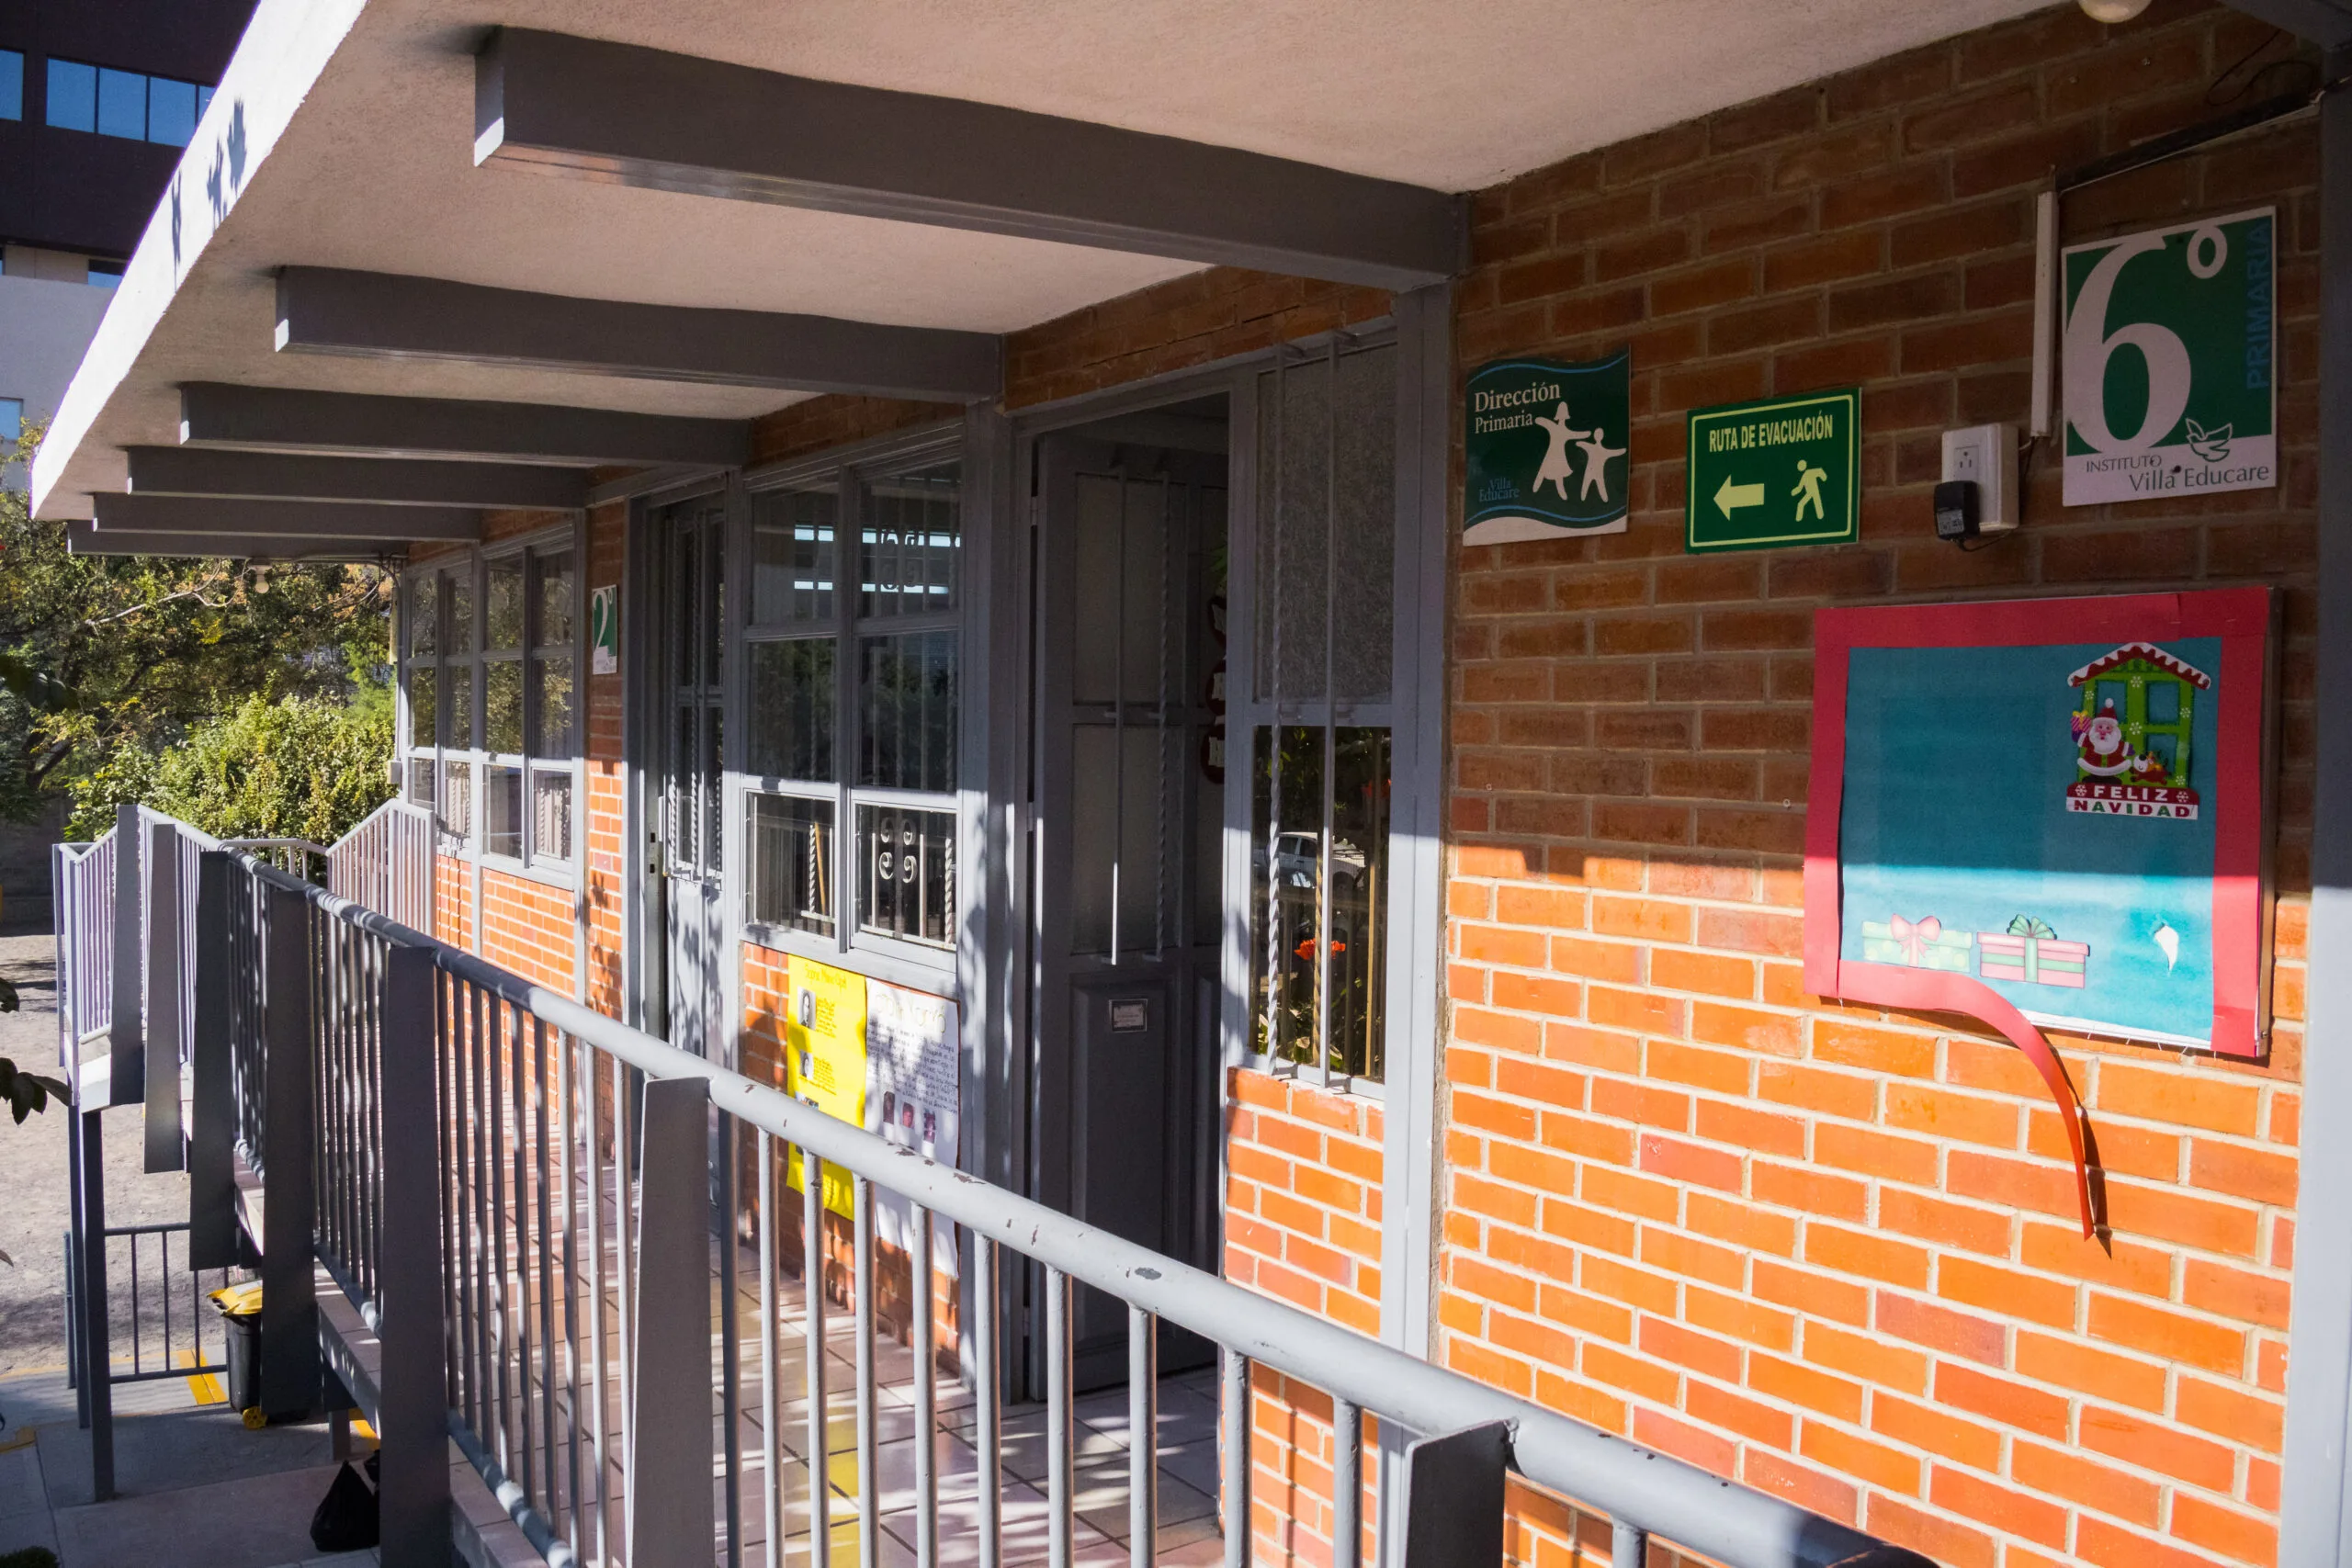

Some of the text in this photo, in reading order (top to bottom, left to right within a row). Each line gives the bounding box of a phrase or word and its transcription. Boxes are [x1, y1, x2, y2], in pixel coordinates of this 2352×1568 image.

[2247, 220, 2270, 389] PRIMARIA
[1475, 382, 1560, 412] Dirección
[1475, 410, 1533, 434] Primaria
[1709, 411, 1833, 453] RUTA DE EVACUACIÓN
[2086, 454, 2162, 473] INSTITUTO
[1490, 477, 1511, 490] Villa
[2129, 465, 2270, 492] Villa Educare
[1479, 487, 1521, 502] Educare
[2094, 785, 2168, 801] FELIZ
[2075, 801, 2190, 818] NAVIDAD
